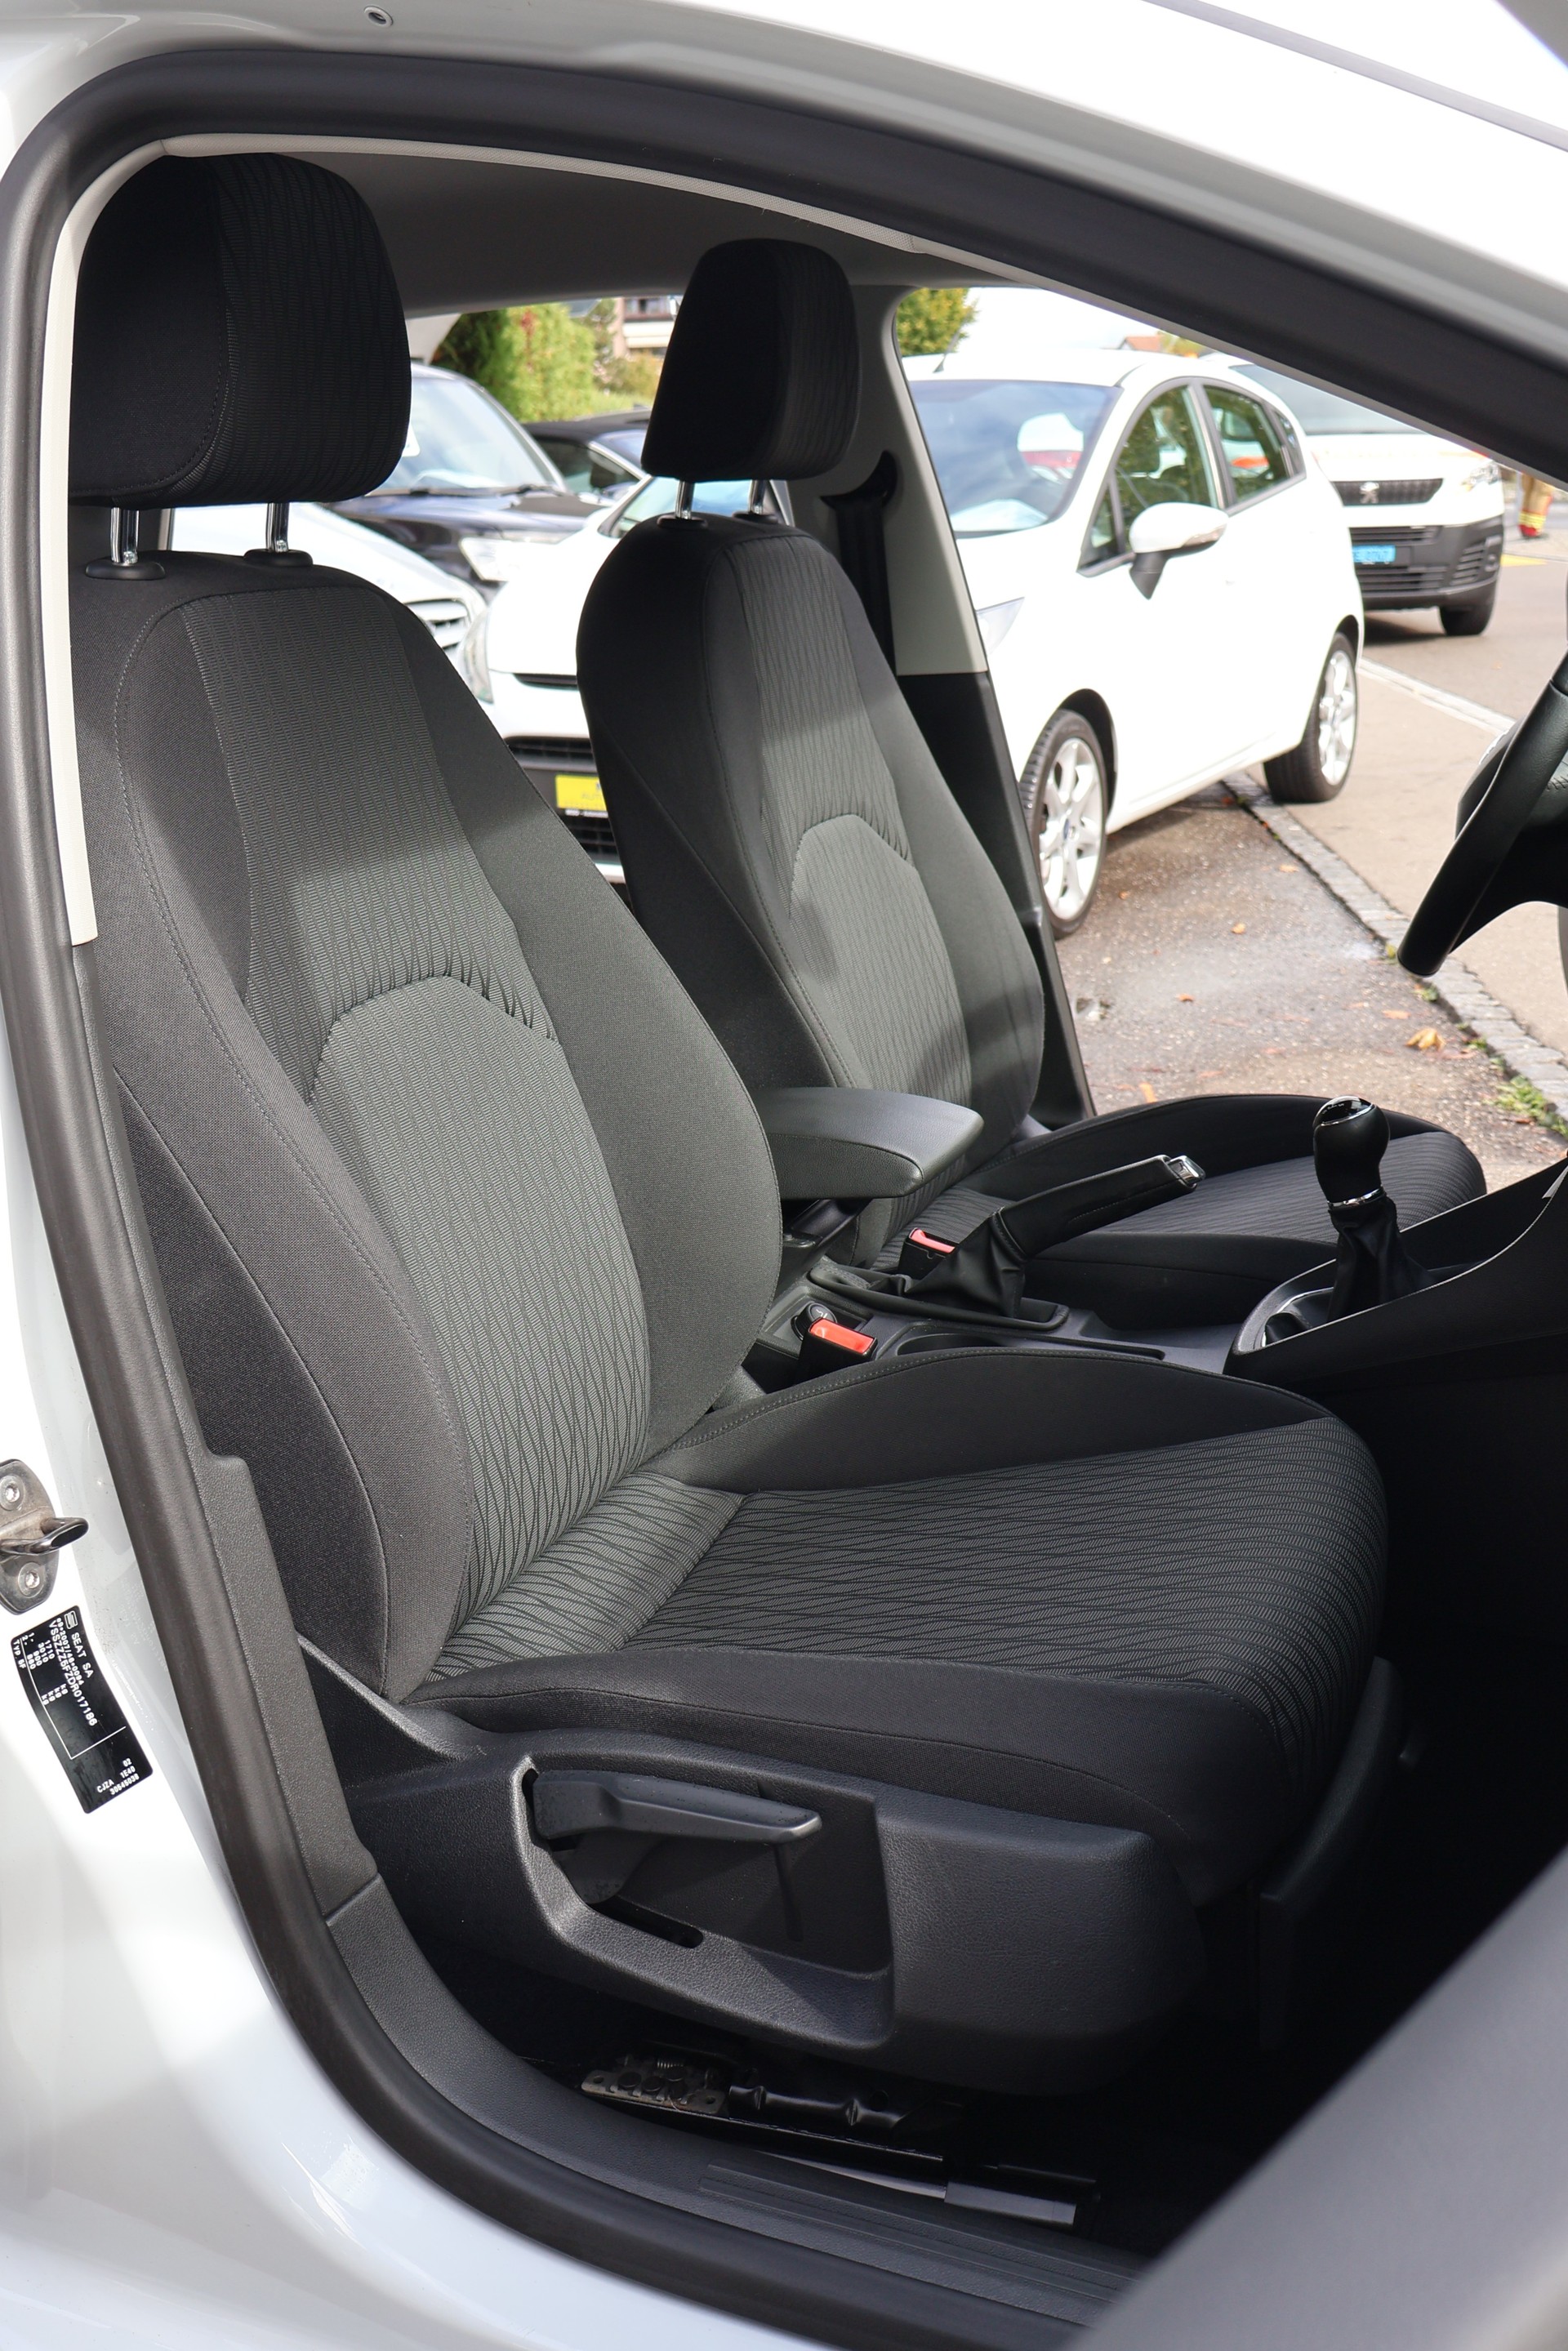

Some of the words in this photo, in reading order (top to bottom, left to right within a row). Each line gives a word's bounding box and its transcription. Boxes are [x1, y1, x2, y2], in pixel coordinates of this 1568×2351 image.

[33, 1650, 42, 1667] 900
[38, 1642, 49, 1663] 3010
[45, 1640, 56, 1659] 1710
[72, 1632, 87, 1658] SEAT
[82, 1663, 94, 1678] SA
[122, 1757, 132, 1767] 02
[96, 1779, 114, 1793] CJZA
